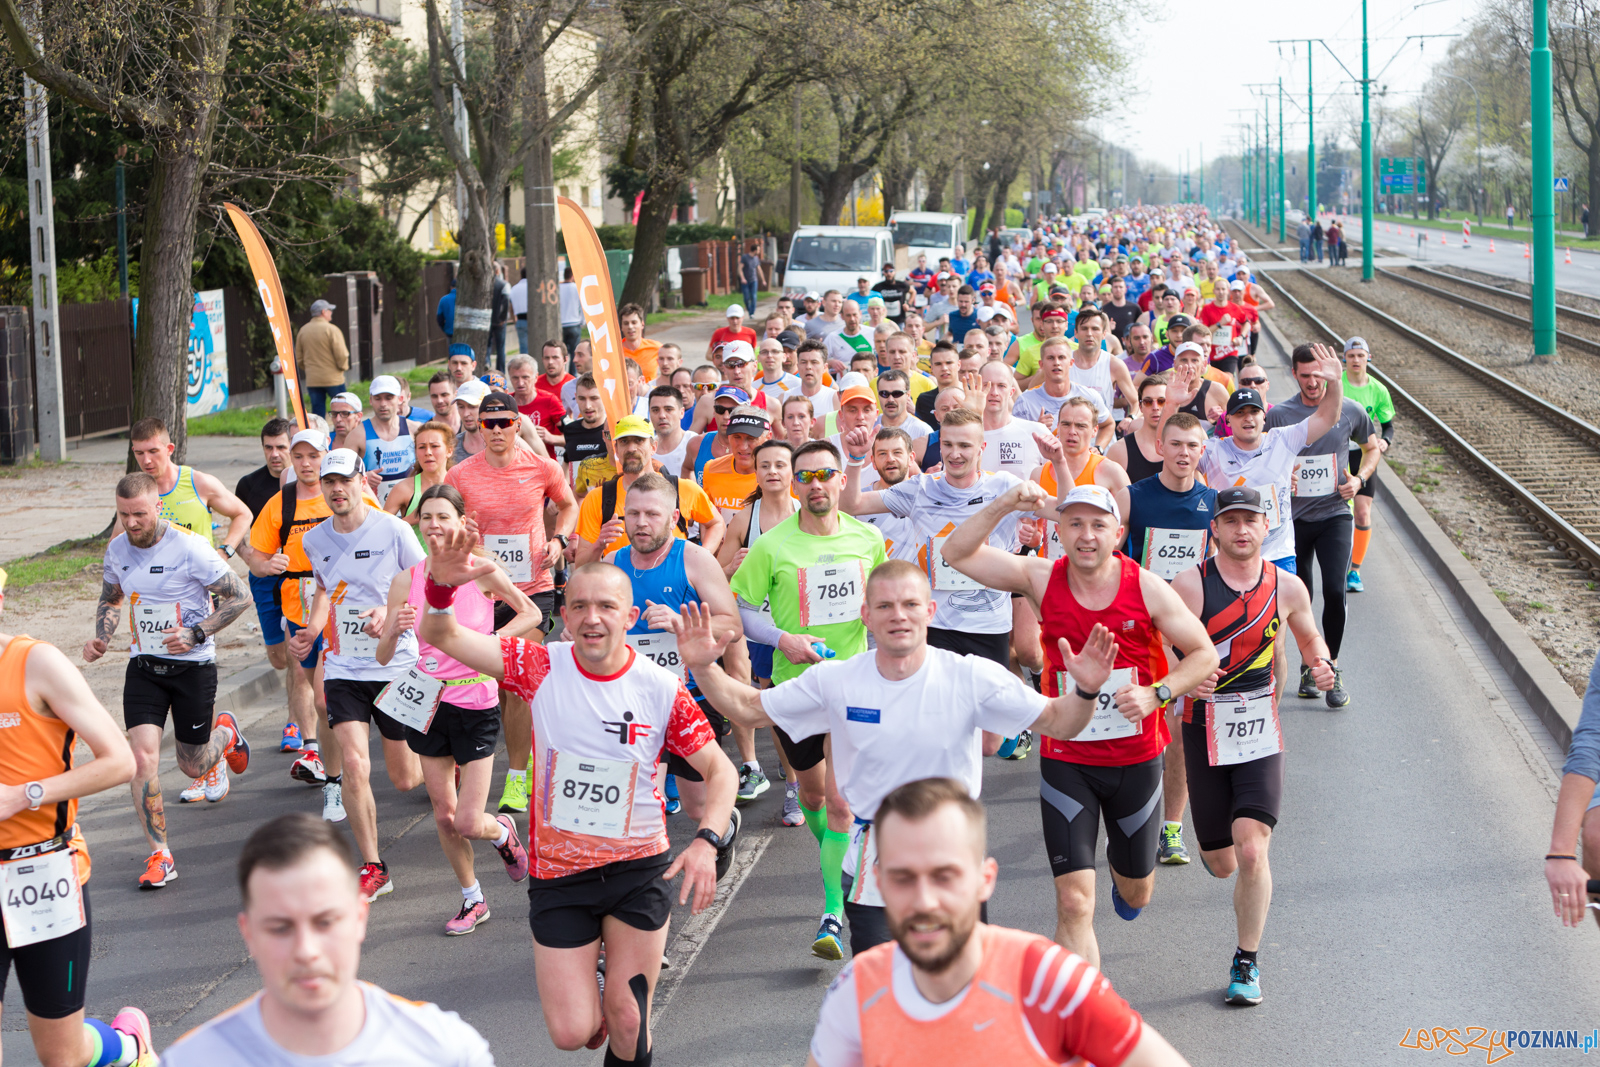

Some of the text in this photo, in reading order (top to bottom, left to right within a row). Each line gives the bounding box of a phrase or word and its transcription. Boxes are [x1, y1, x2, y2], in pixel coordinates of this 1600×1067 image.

[731, 417, 761, 426] DAILY
[383, 450, 409, 459] RUNNERS
[382, 457, 402, 465] POWER
[1301, 468, 1329, 480] 8991
[714, 497, 746, 508] MAJE
[1158, 545, 1196, 559] 6254
[817, 580, 855, 600] 7861
[397, 681, 425, 706] 452
[1225, 717, 1265, 738] 7877
[562, 779, 621, 805] 8750
[577, 804, 600, 813] Marcin
[7, 877, 70, 909] 4040
[31, 907, 53, 916] Marek
